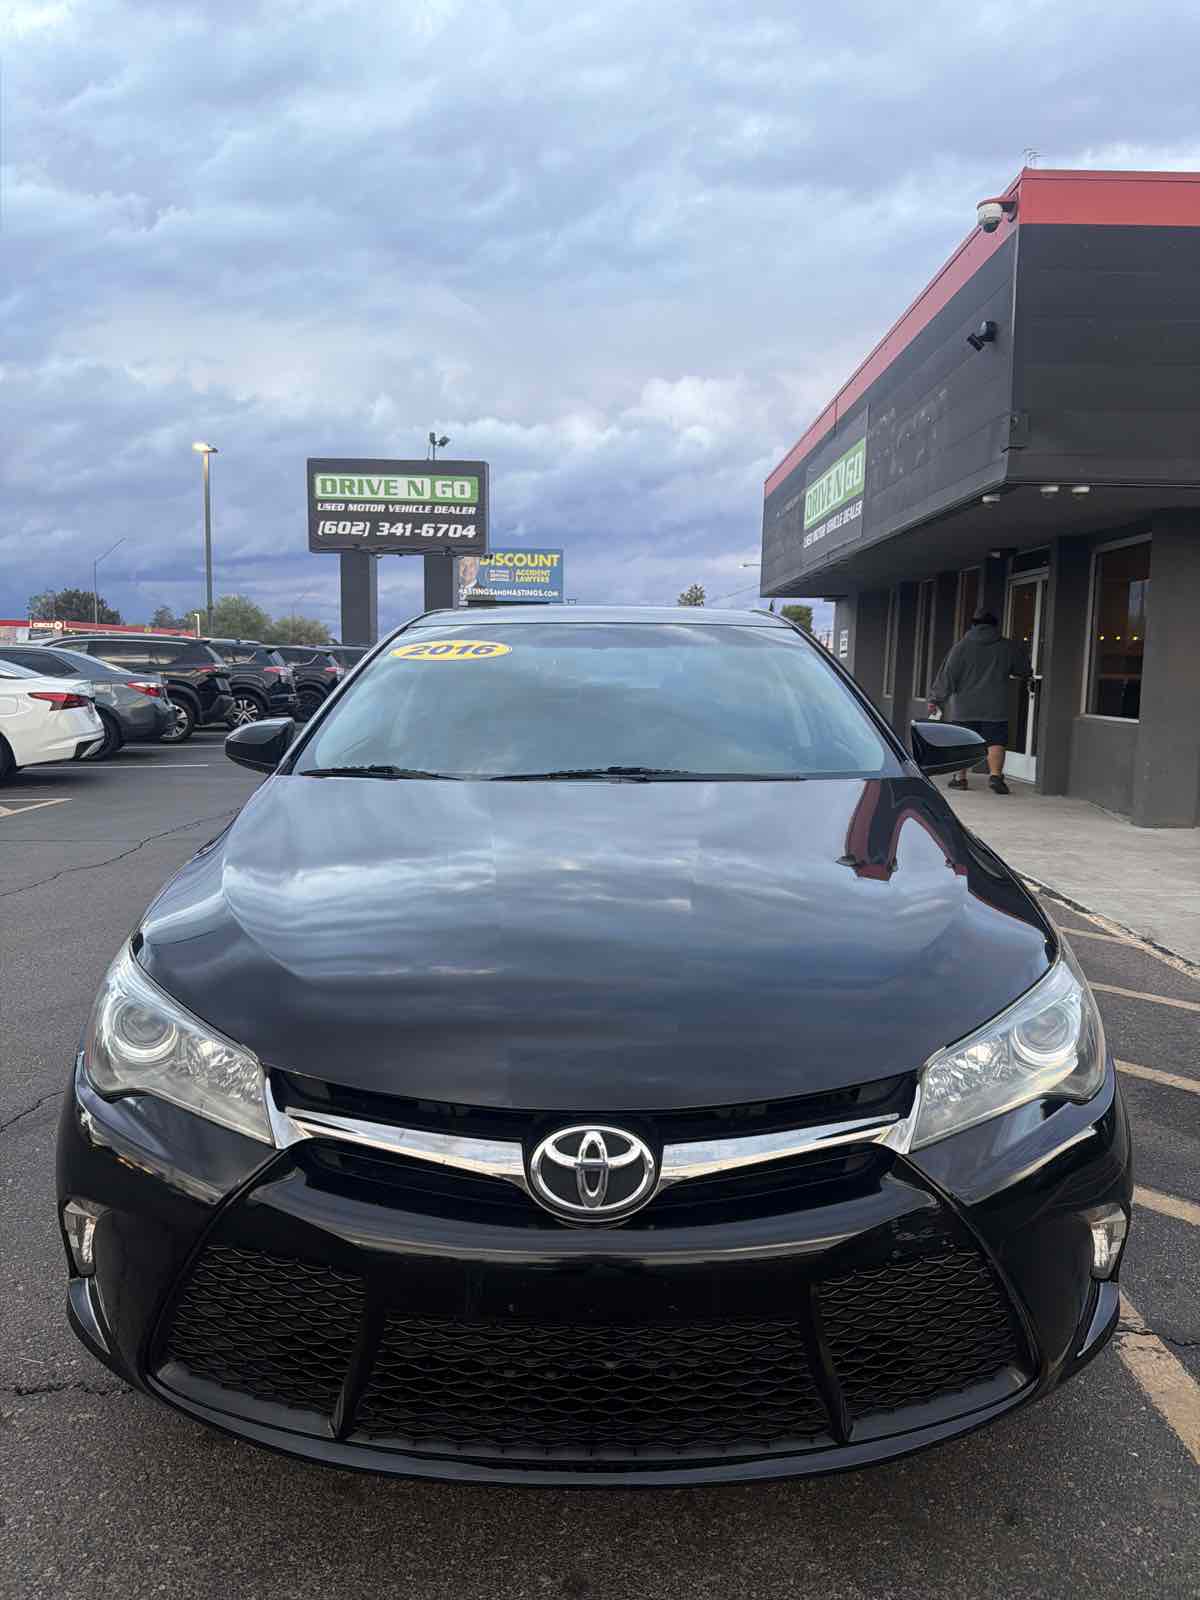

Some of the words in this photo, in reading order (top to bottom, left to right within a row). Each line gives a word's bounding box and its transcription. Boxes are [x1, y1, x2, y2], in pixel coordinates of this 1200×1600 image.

[847, 452, 863, 490] GO
[320, 479, 398, 496] DRIVE
[408, 479, 424, 497] N
[435, 480, 471, 498] GO
[318, 503, 345, 511] USED
[347, 503, 385, 512] MOTOR
[388, 504, 432, 513] VEHICLE
[434, 505, 476, 515] DEALER
[318, 520, 370, 537] (602)
[376, 521, 476, 538] 341-6704
[402, 644, 498, 657] 2016
